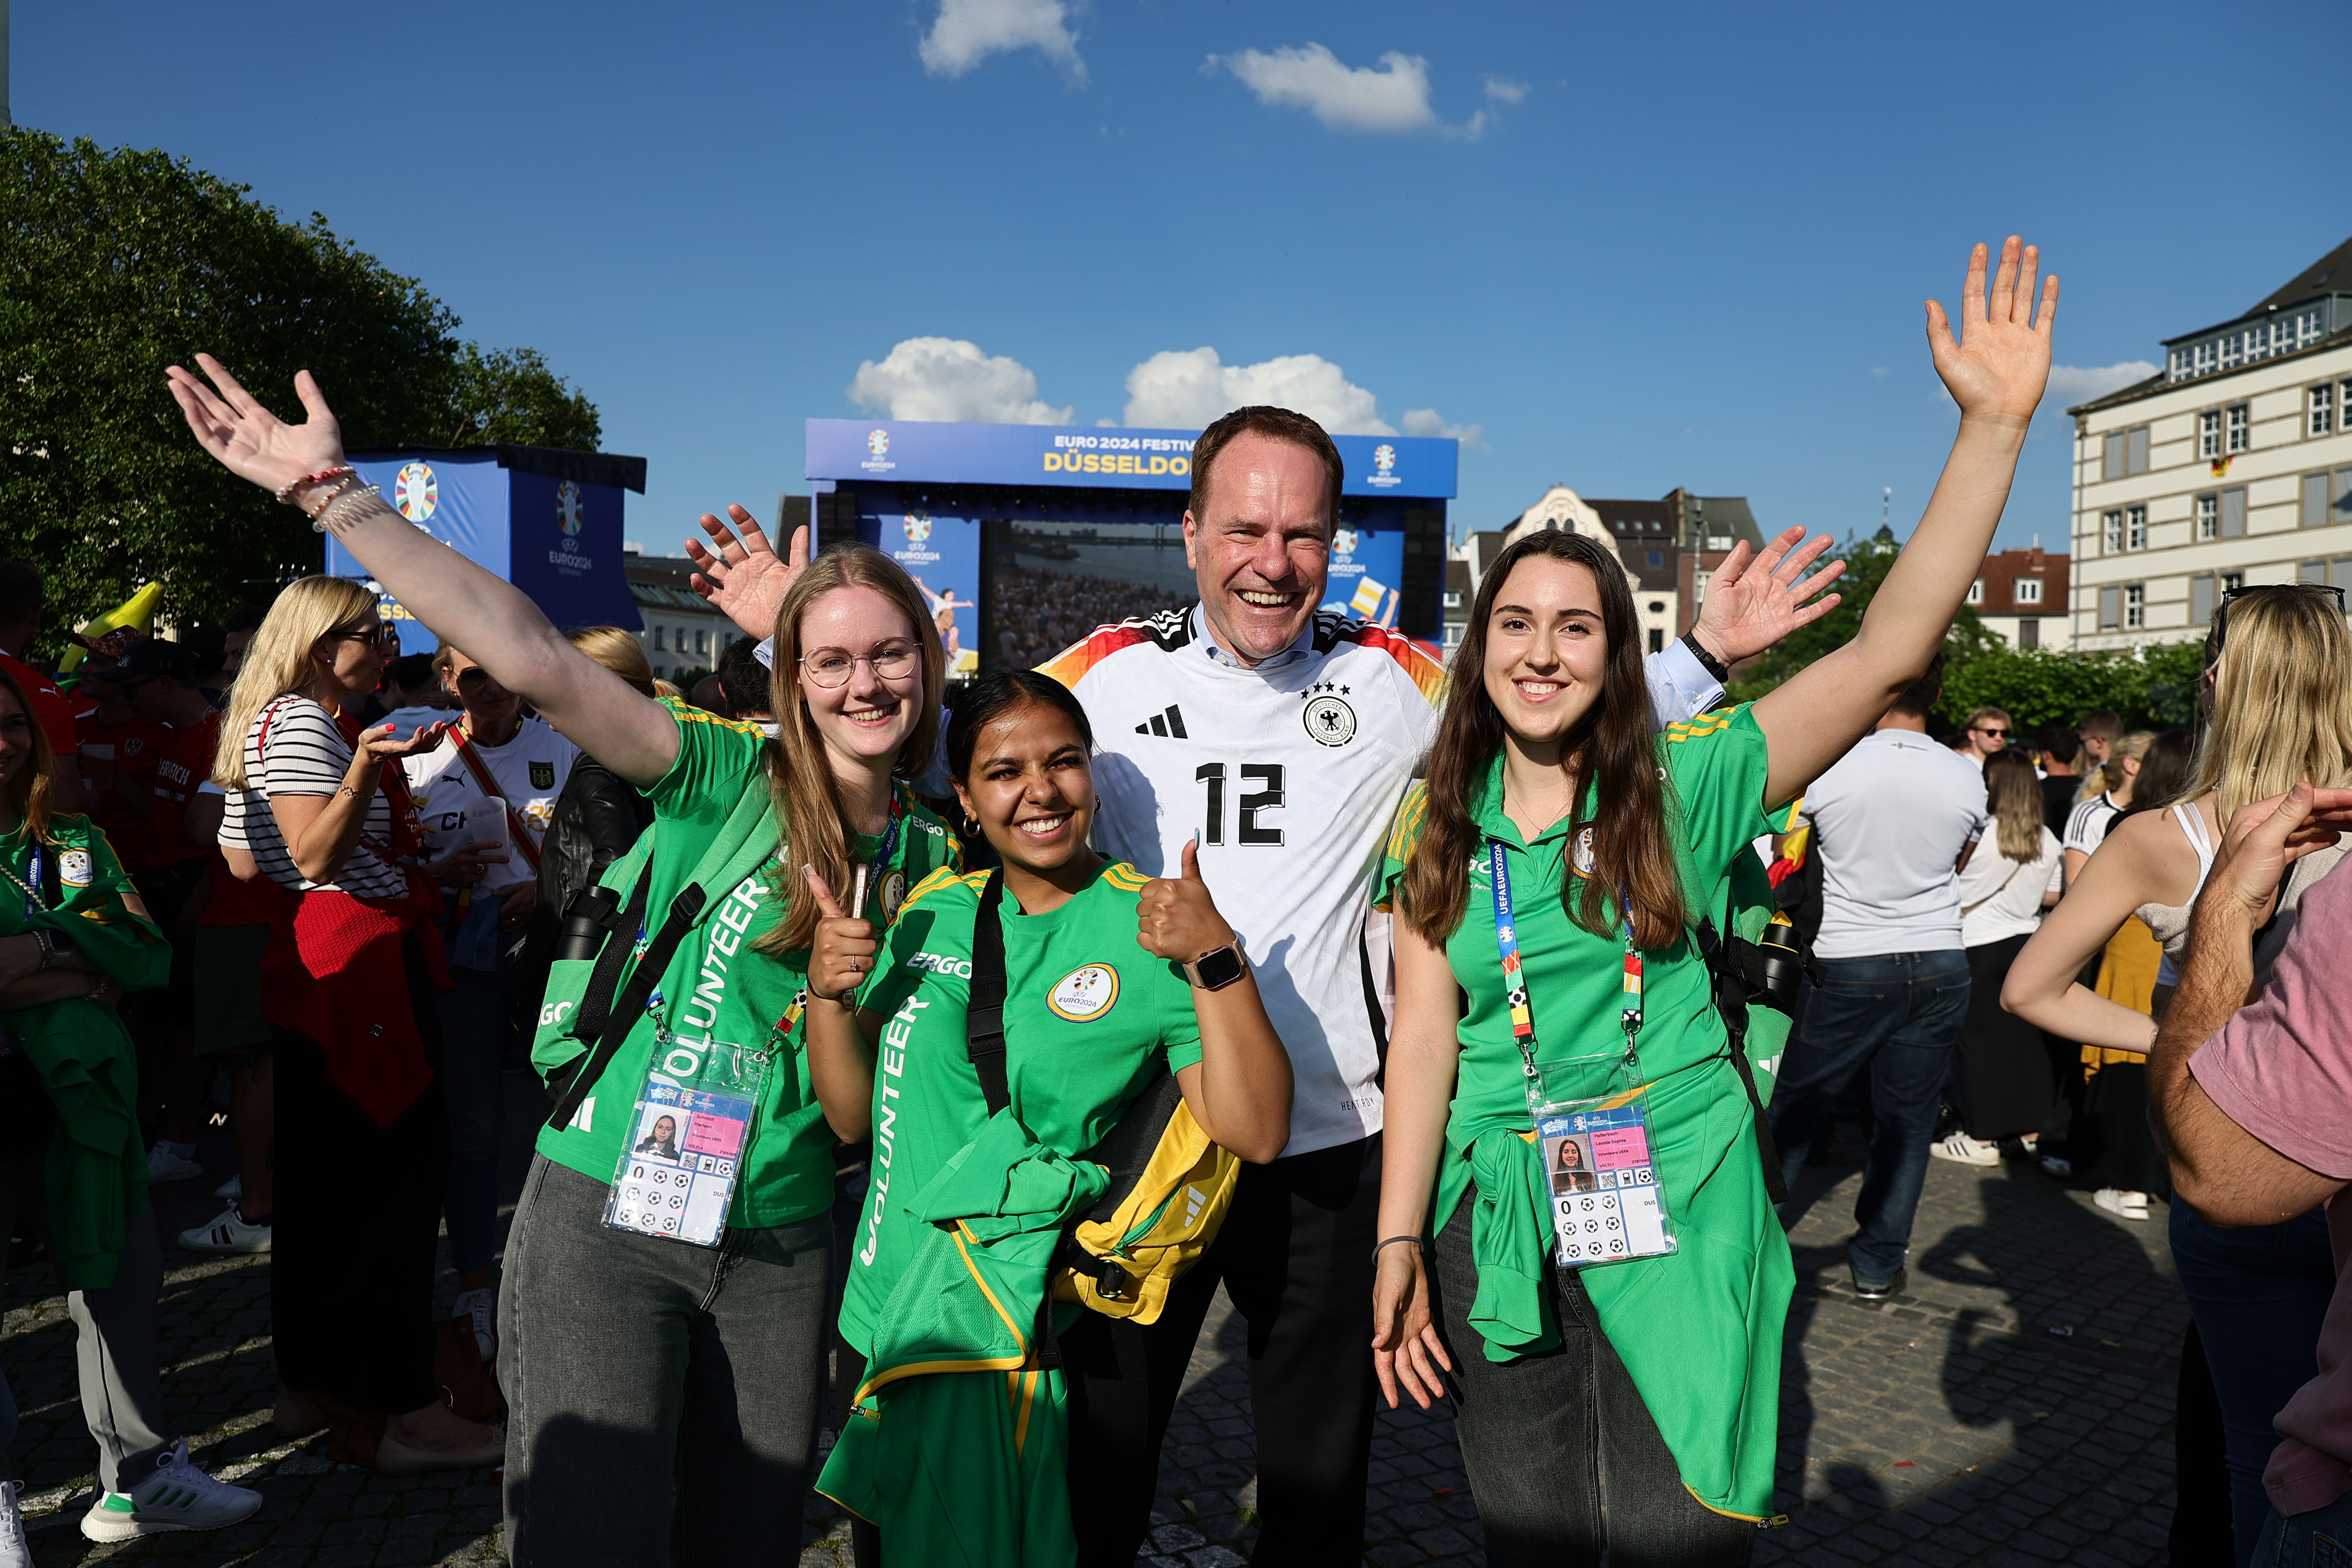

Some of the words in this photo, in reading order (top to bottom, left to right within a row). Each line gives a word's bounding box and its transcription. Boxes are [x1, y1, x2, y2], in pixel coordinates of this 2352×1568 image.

[1054, 435, 1098, 449] EURO
[1099, 437, 1140, 450] 2024
[1044, 448, 1191, 476] DÜSSELDO
[549, 550, 592, 570] EURO2024
[1313, 702, 1342, 713] DEUTSCHER
[1314, 725, 1350, 740] FUSSBALL-BUND
[1195, 763, 1286, 846] 12
[912, 815, 944, 837] ERGO
[906, 951, 972, 980] ERGO
[1058, 997, 1097, 1007] EURO2024
[1341, 1097, 1375, 1111] HEAT.RDY
